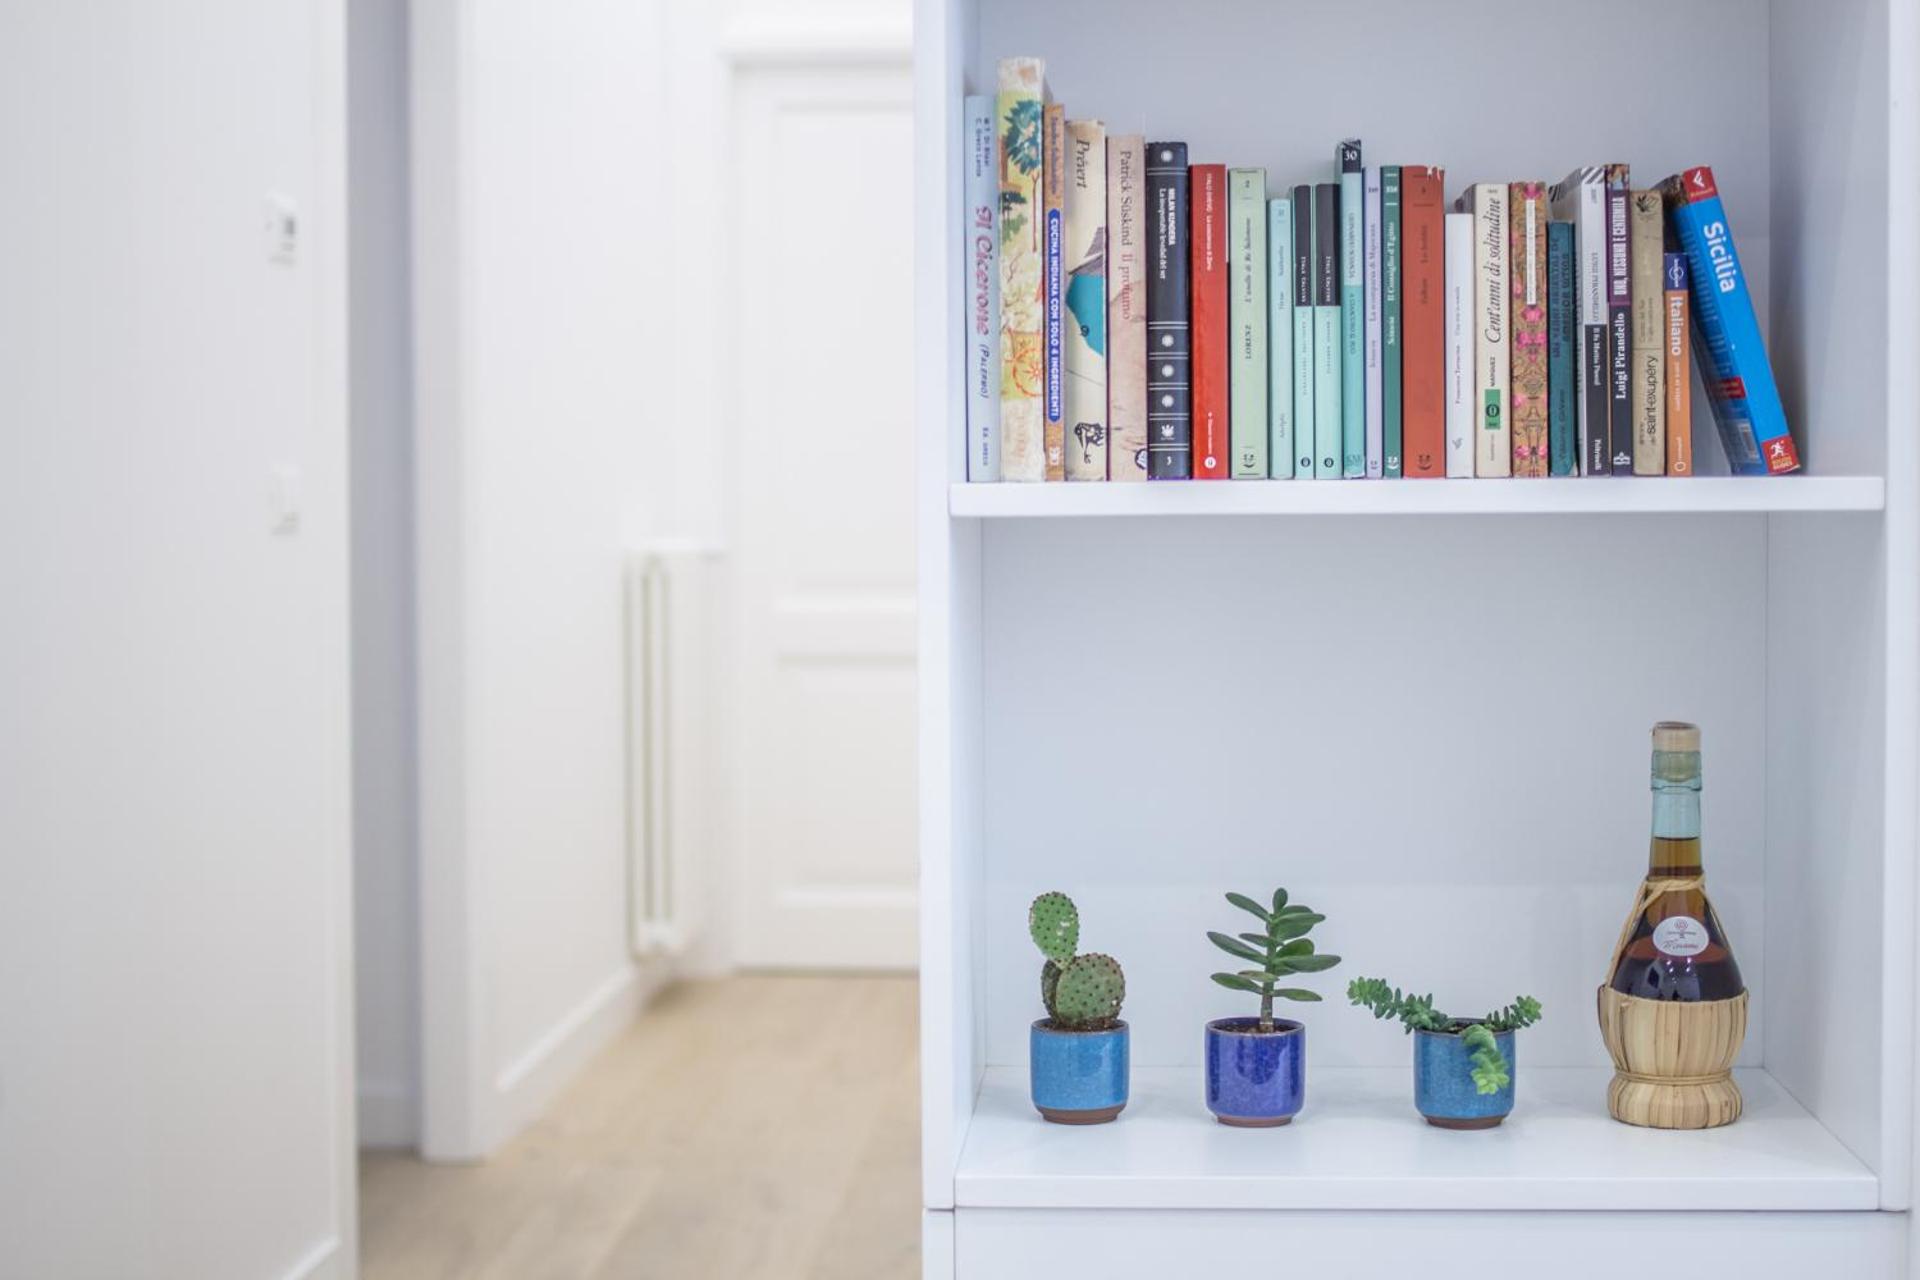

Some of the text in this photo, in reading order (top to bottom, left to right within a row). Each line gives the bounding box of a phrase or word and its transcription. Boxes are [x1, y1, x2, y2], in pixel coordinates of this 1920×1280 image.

[1075, 138, 1090, 188] Prévert
[1120, 150, 1133, 194] Patrick
[1344, 150, 1358, 160] 30
[1159, 188, 1166, 198] La
[1168, 188, 1176, 246] MILAN KUNDERA
[1612, 196, 1626, 236] CENTOMILA
[1050, 218, 1058, 254] CUCINA
[1120, 196, 1133, 246] Süskind
[1482, 198, 1502, 260] solitudine
[1050, 256, 1058, 297] INDIANA
[1482, 261, 1500, 276] di
[1612, 242, 1626, 276] NESSUNO
[1703, 221, 1737, 293] Sicilia
[976, 235, 993, 336] Cicerone
[1050, 298, 1059, 320] CON
[1118, 266, 1133, 320] profumo
[1050, 321, 1059, 346] SOLO
[1484, 280, 1502, 344] Cent'anni
[1670, 296, 1684, 356] Italiano
[1614, 312, 1627, 399] Luigi Pirandello
[1050, 357, 1059, 416] INGREDIENTI
